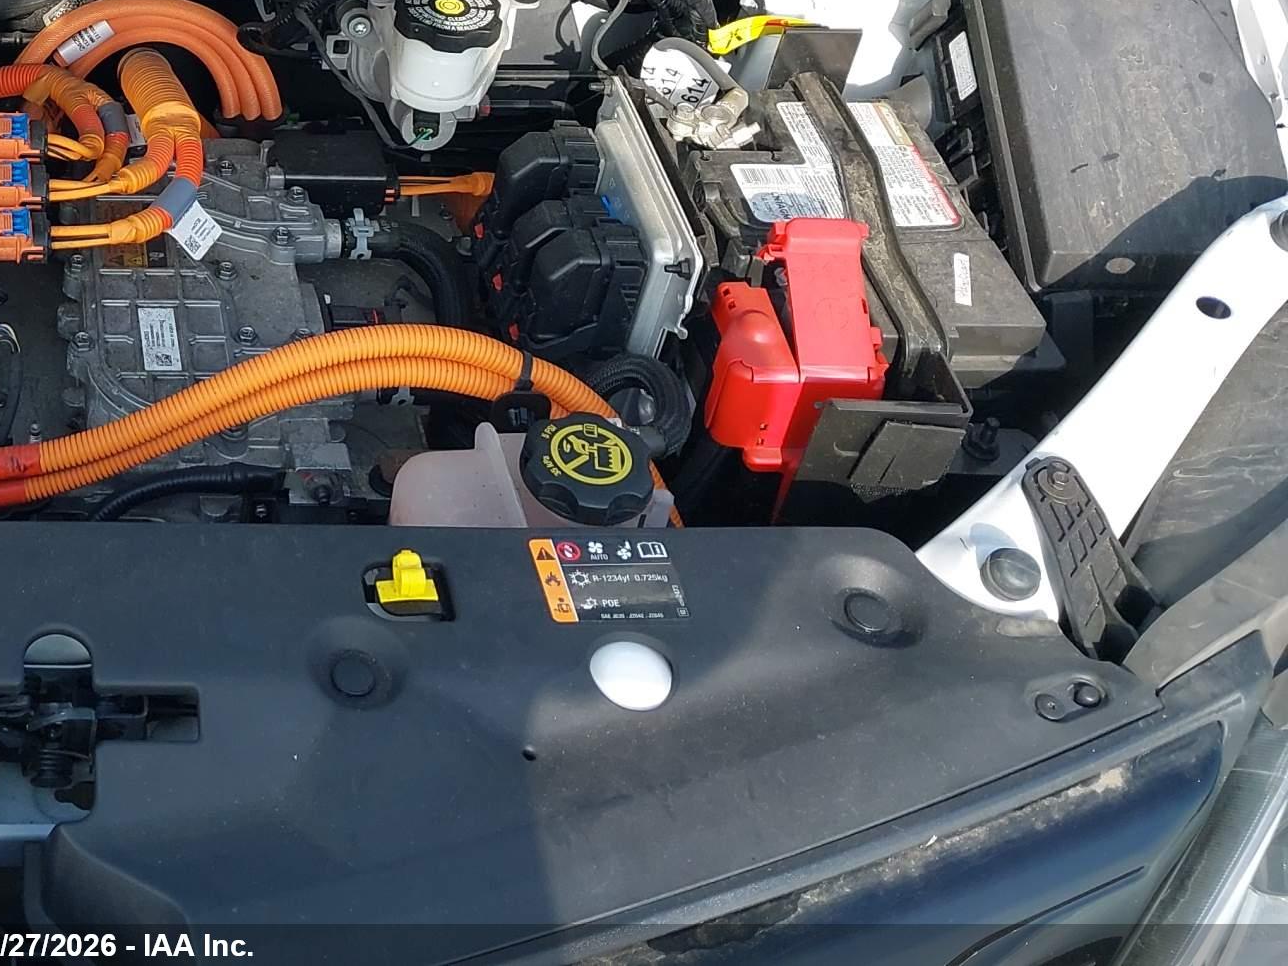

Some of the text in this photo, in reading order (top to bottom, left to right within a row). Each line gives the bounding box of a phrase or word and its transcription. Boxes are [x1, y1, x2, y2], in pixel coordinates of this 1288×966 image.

[681, 77, 710, 103] 614
[634, 573, 669, 582] 0.725kg
[602, 599, 621, 607] POE
